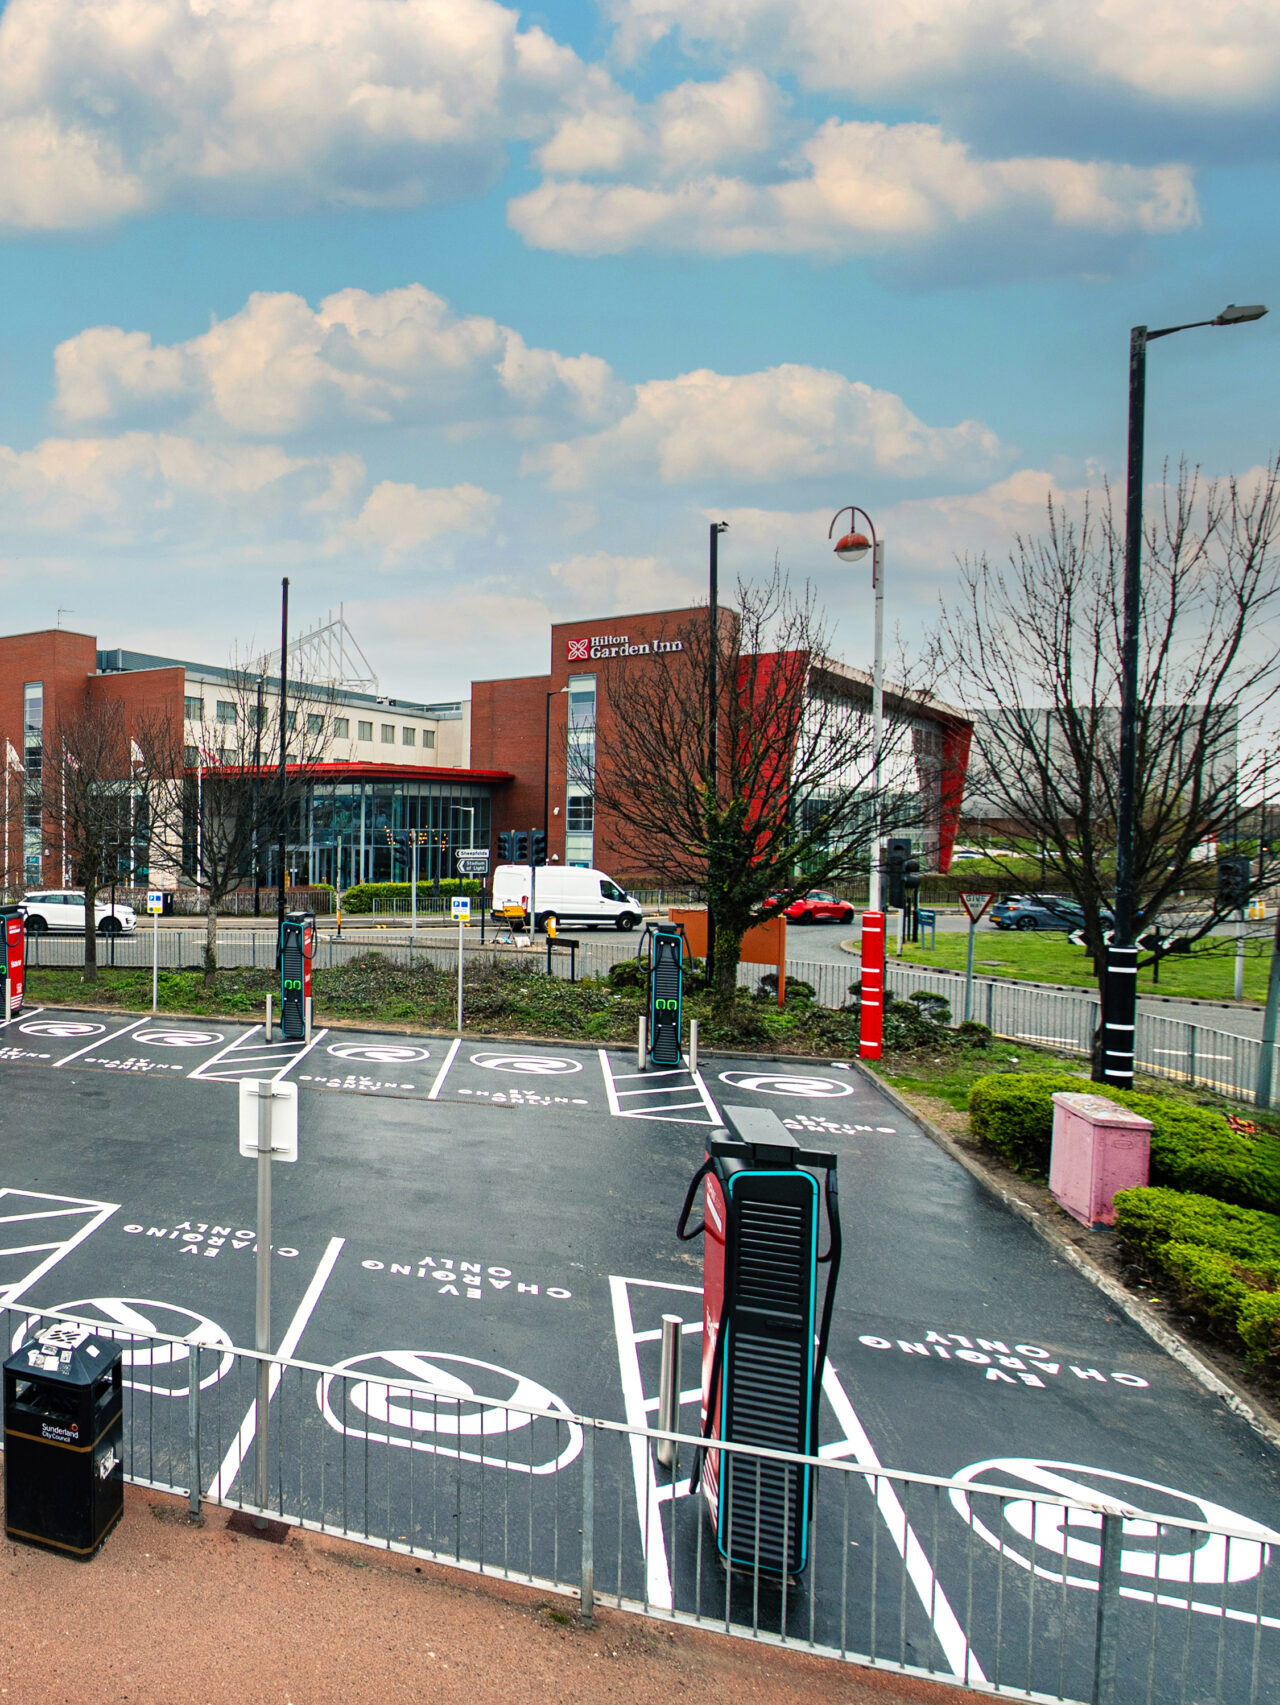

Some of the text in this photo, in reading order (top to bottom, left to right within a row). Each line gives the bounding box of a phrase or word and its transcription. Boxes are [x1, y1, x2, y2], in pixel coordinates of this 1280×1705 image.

[590, 639, 684, 659] Garden Inn
[591, 635, 629, 646] Hilton
[782, 1119, 897, 1134] ARGING
[795, 1114, 826, 1122] EV
[784, 1124, 856, 1135] ONLY
[175, 1221, 256, 1239] ONLY
[179, 1243, 220, 1257] EV
[418, 1256, 512, 1277] ONLY
[361, 1259, 572, 1300] CHARGING
[437, 1283, 482, 1300] EV
[925, 1330, 1051, 1359] ONLY
[858, 1335, 1150, 1388] CHARGING
[985, 1367, 1047, 1388] EV
[42, 1422, 79, 1439] Sunderland
